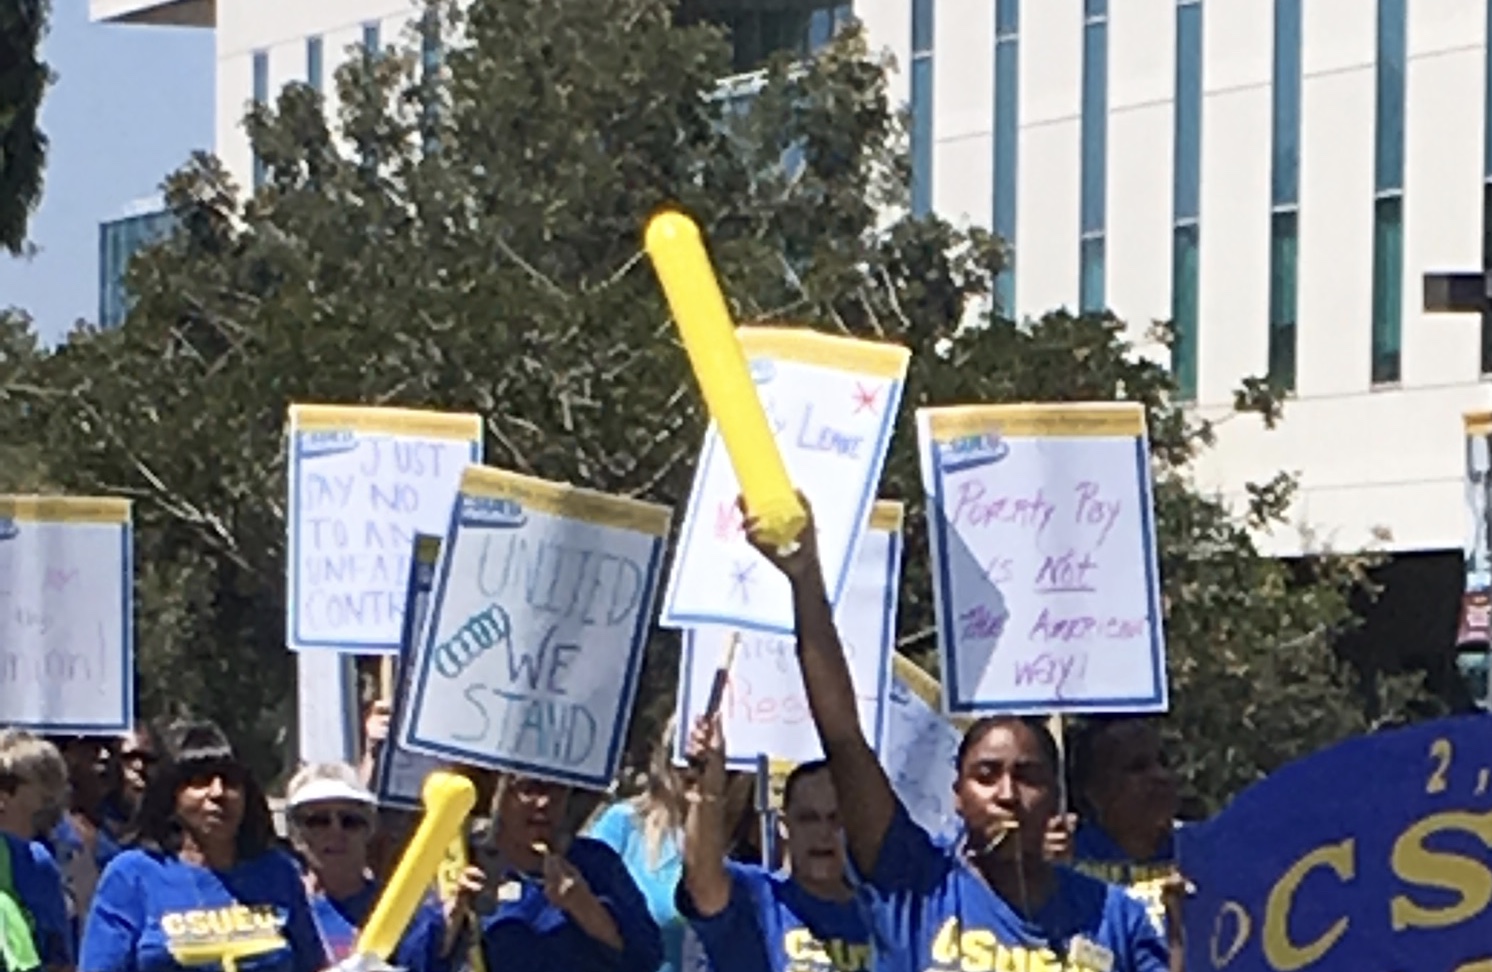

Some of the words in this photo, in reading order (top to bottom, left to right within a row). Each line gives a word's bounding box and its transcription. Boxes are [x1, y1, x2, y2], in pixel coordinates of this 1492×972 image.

[361, 438, 446, 478] JUST
[371, 482, 419, 512] NO
[306, 518, 348, 548] TO
[305, 554, 407, 587] UNFAI
[478, 533, 643, 625] UNITED
[304, 588, 405, 632] CONTR
[503, 608, 582, 695] WE
[450, 683, 598, 766] STAND
